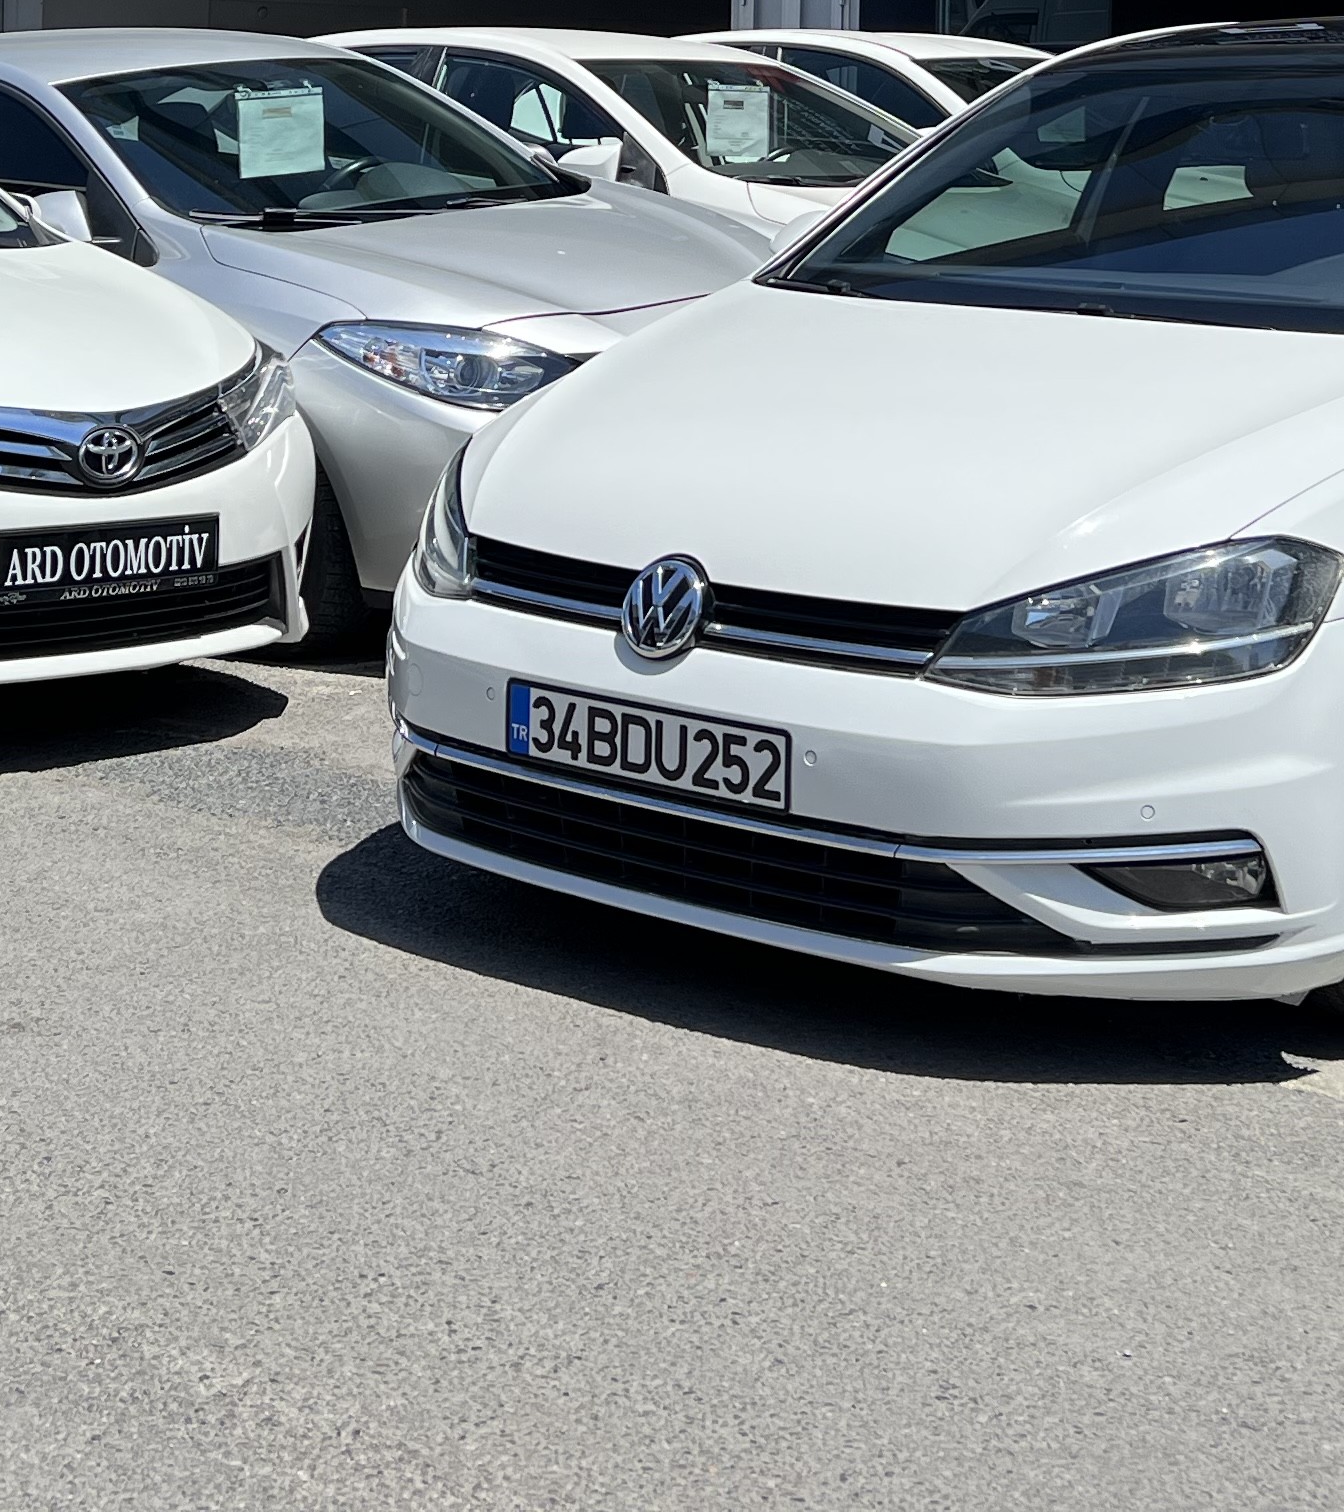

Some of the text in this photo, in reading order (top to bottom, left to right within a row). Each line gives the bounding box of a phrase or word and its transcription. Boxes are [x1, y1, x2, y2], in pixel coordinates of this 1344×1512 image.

[4, 525, 209, 586] ARD OTOMOTİV
[60, 588, 90, 600] ARD
[511, 722, 528, 742] TR
